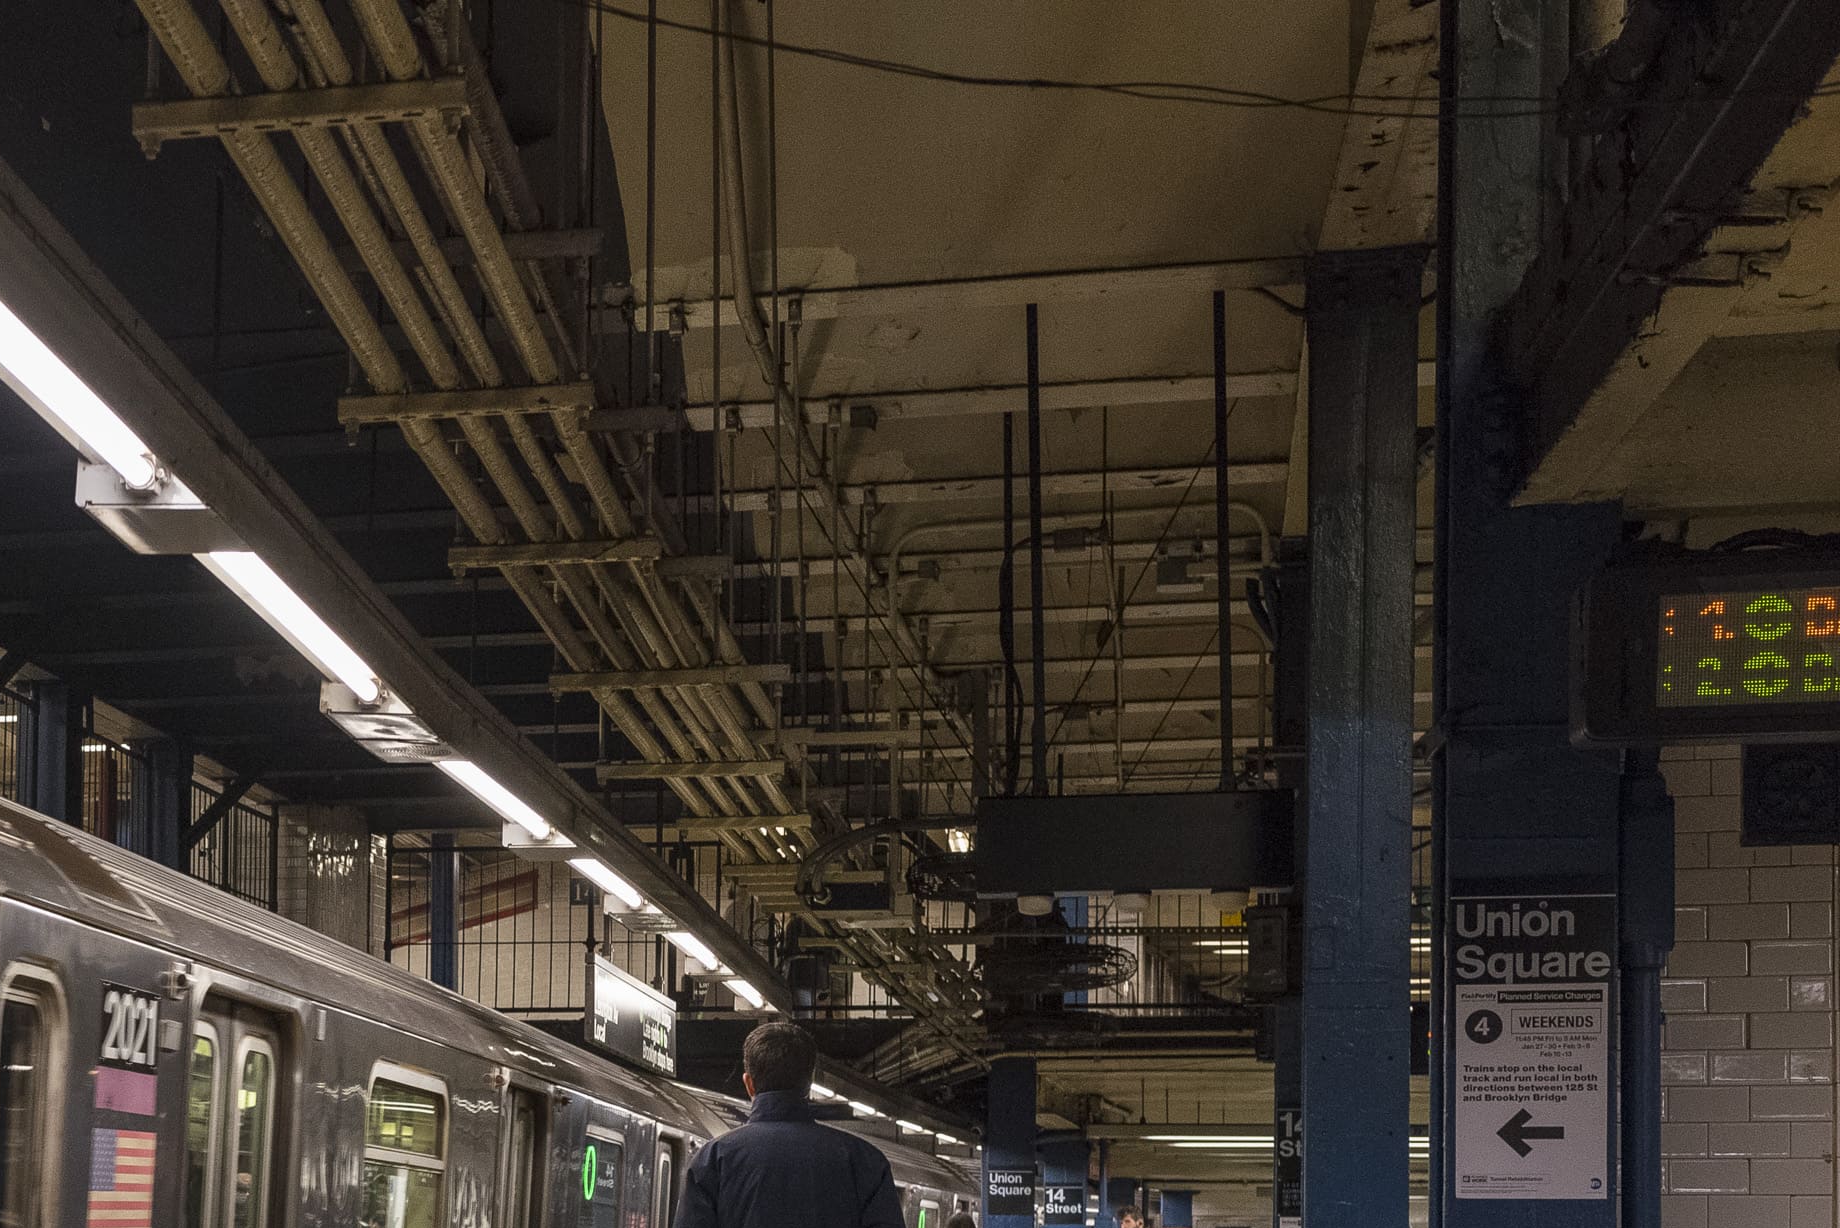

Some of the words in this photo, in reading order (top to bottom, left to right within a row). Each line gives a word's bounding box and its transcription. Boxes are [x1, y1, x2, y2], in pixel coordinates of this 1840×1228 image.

[1456, 902, 1575, 938] Union
[1456, 944, 1611, 984] Square
[1500, 992, 1532, 1001] Planned
[1534, 992, 1563, 1000] Service
[1565, 991, 1601, 1001] Changes
[101, 990, 158, 1065] 2021
[1474, 1016, 1490, 1036] 4
[1518, 1015, 1594, 1028] WEEKENDS
[1464, 1065, 1495, 1073] Trains
[1498, 1065, 1520, 1074] stop
[1557, 1064, 1582, 1072] local
[1463, 1074, 1490, 1082] track
[1492, 1074, 1512, 1082] and
[1534, 1074, 1559, 1082] local
[1463, 1084, 1516, 1092] directions
[1518, 1084, 1563, 1092] between
[1566, 1083, 1584, 1091] 125
[1587, 1083, 1598, 1091] St
[1463, 1094, 1482, 1102] and
[1485, 1094, 1530, 1103] Brooklyn
[1533, 1093, 1567, 1103] Bridge
[989, 1172, 1023, 1184] Union
[989, 1184, 1032, 1198] Square
[1046, 1188, 1066, 1203] 14
[1046, 1203, 1082, 1213] Street
